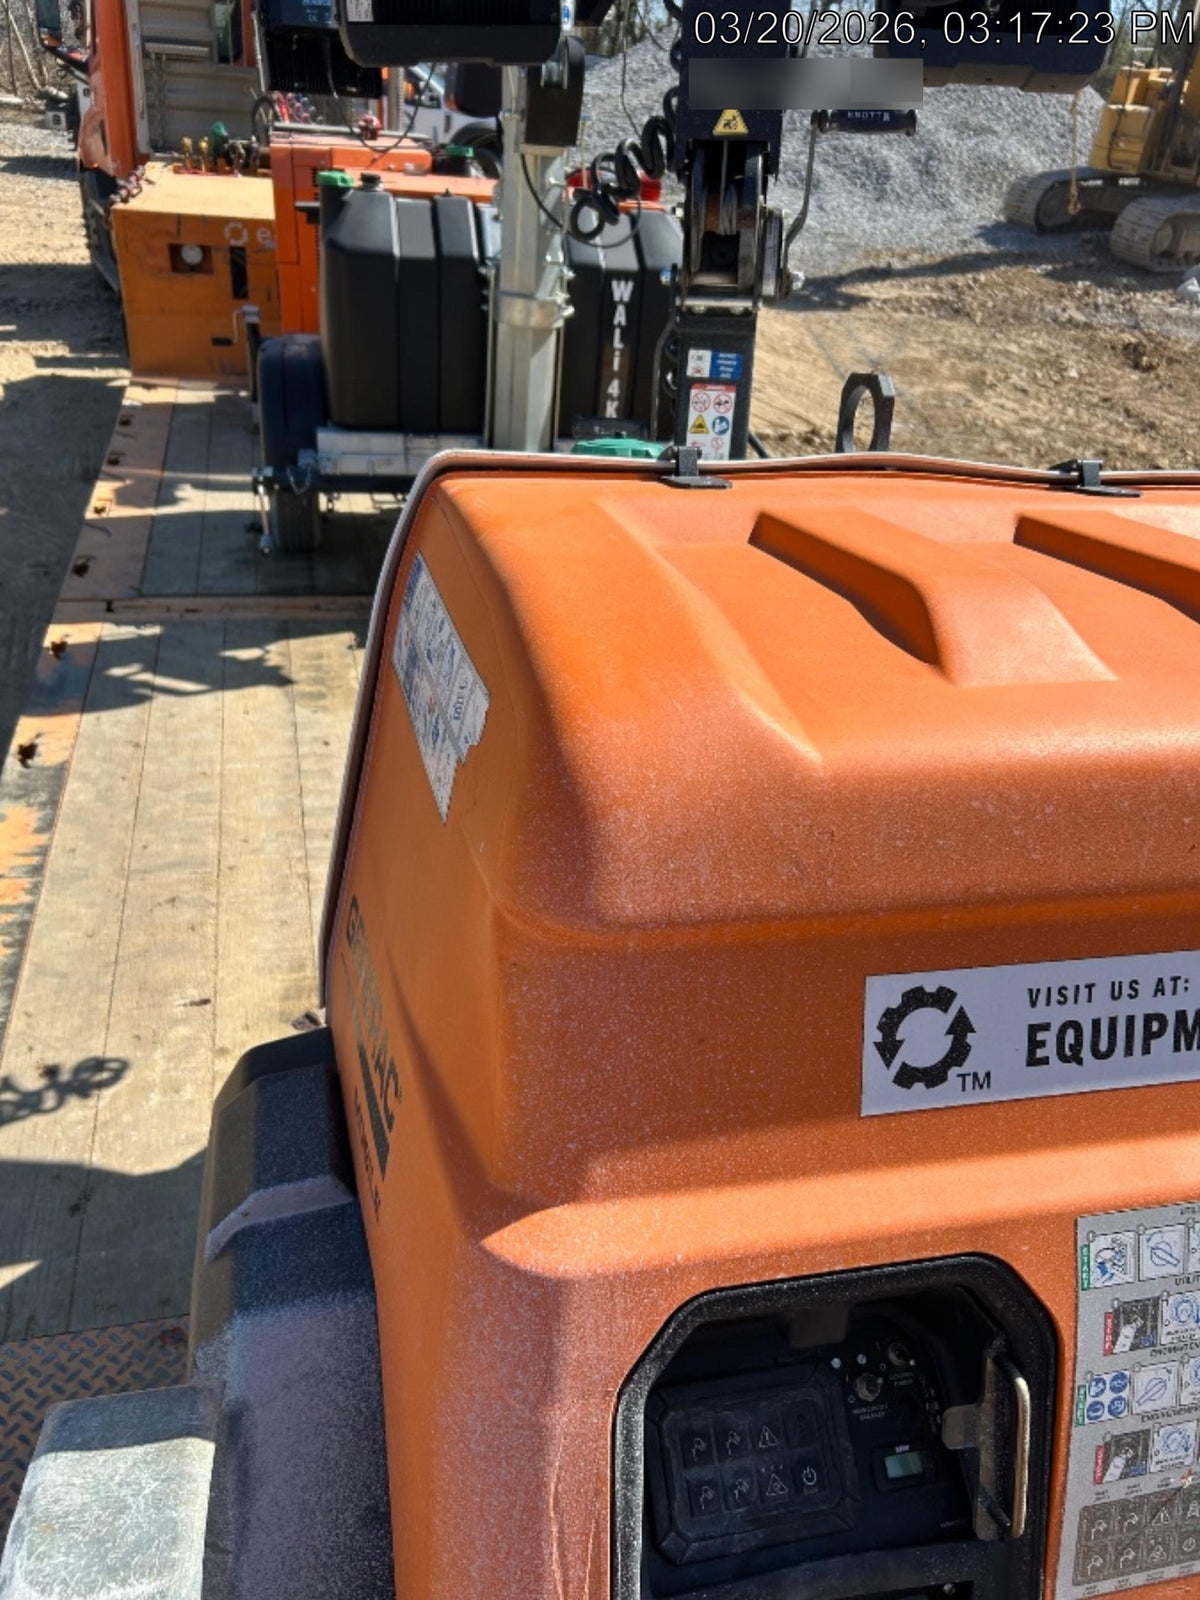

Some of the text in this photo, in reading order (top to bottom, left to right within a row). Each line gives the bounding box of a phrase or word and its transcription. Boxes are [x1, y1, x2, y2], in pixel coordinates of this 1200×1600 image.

[1027, 975, 1190, 1009] VISIT US AT:
[956, 1071, 992, 1092] TM
